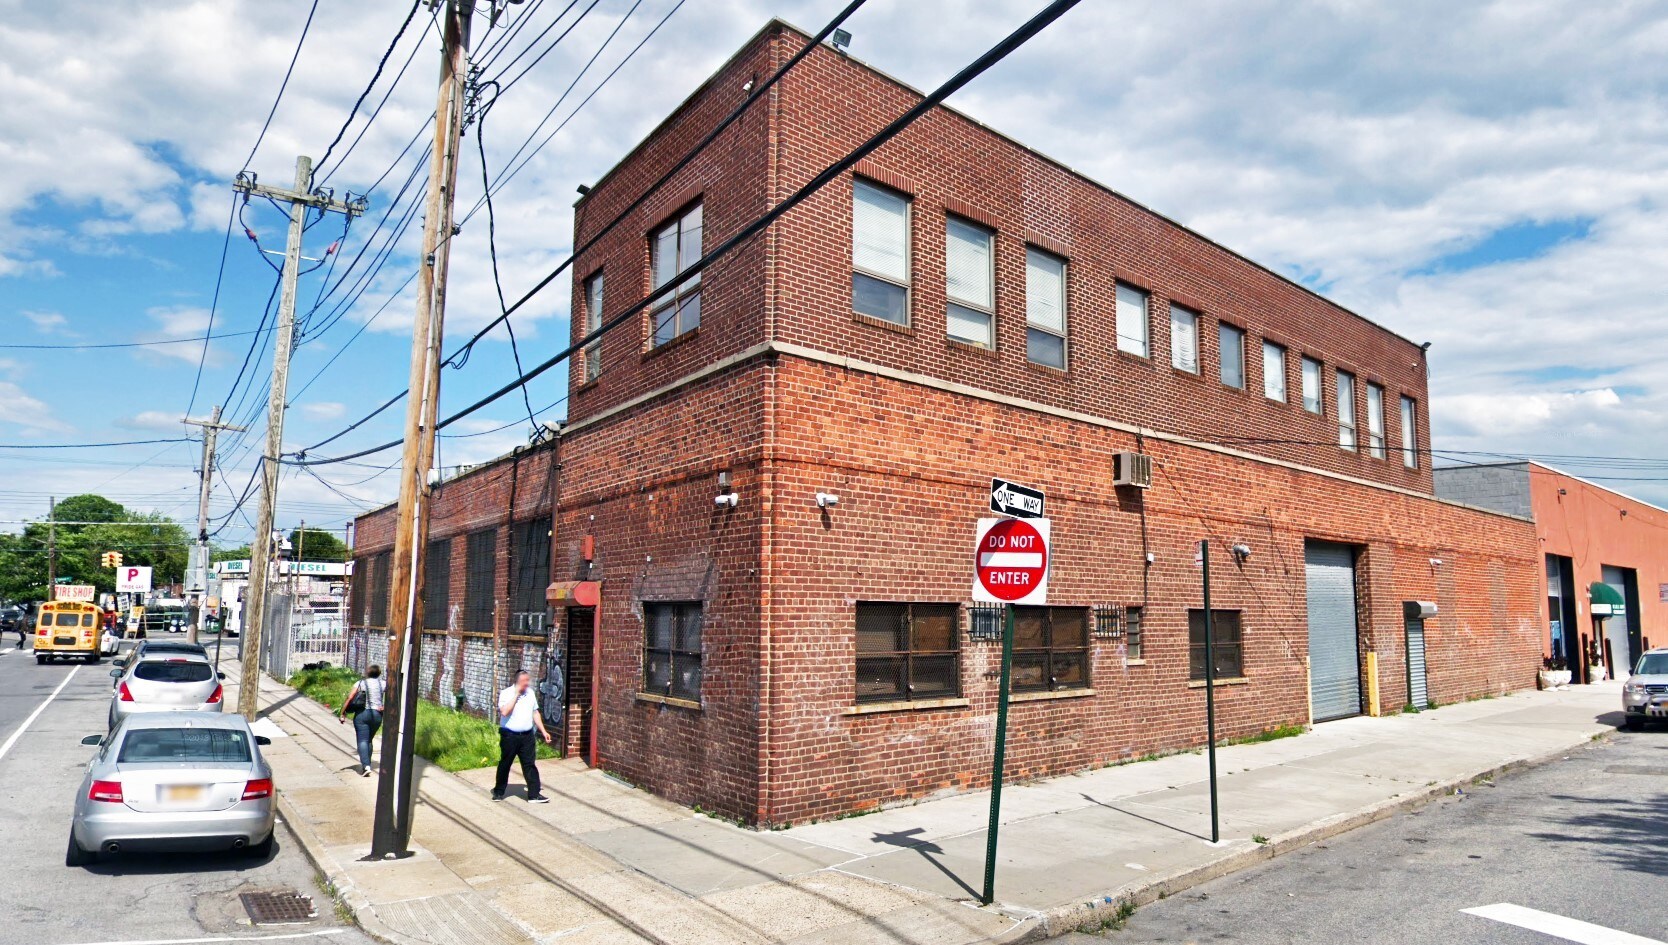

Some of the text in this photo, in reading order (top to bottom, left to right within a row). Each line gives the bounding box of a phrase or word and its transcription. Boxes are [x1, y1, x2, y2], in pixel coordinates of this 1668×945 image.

[997, 490, 1040, 511] ONE WAY
[989, 535, 1035, 548] DO NOT
[228, 562, 243, 570] DIESEL
[128, 568, 138, 581] P
[989, 572, 1029, 585] ENTER
[54, 586, 93, 598] TIRE SHOP
